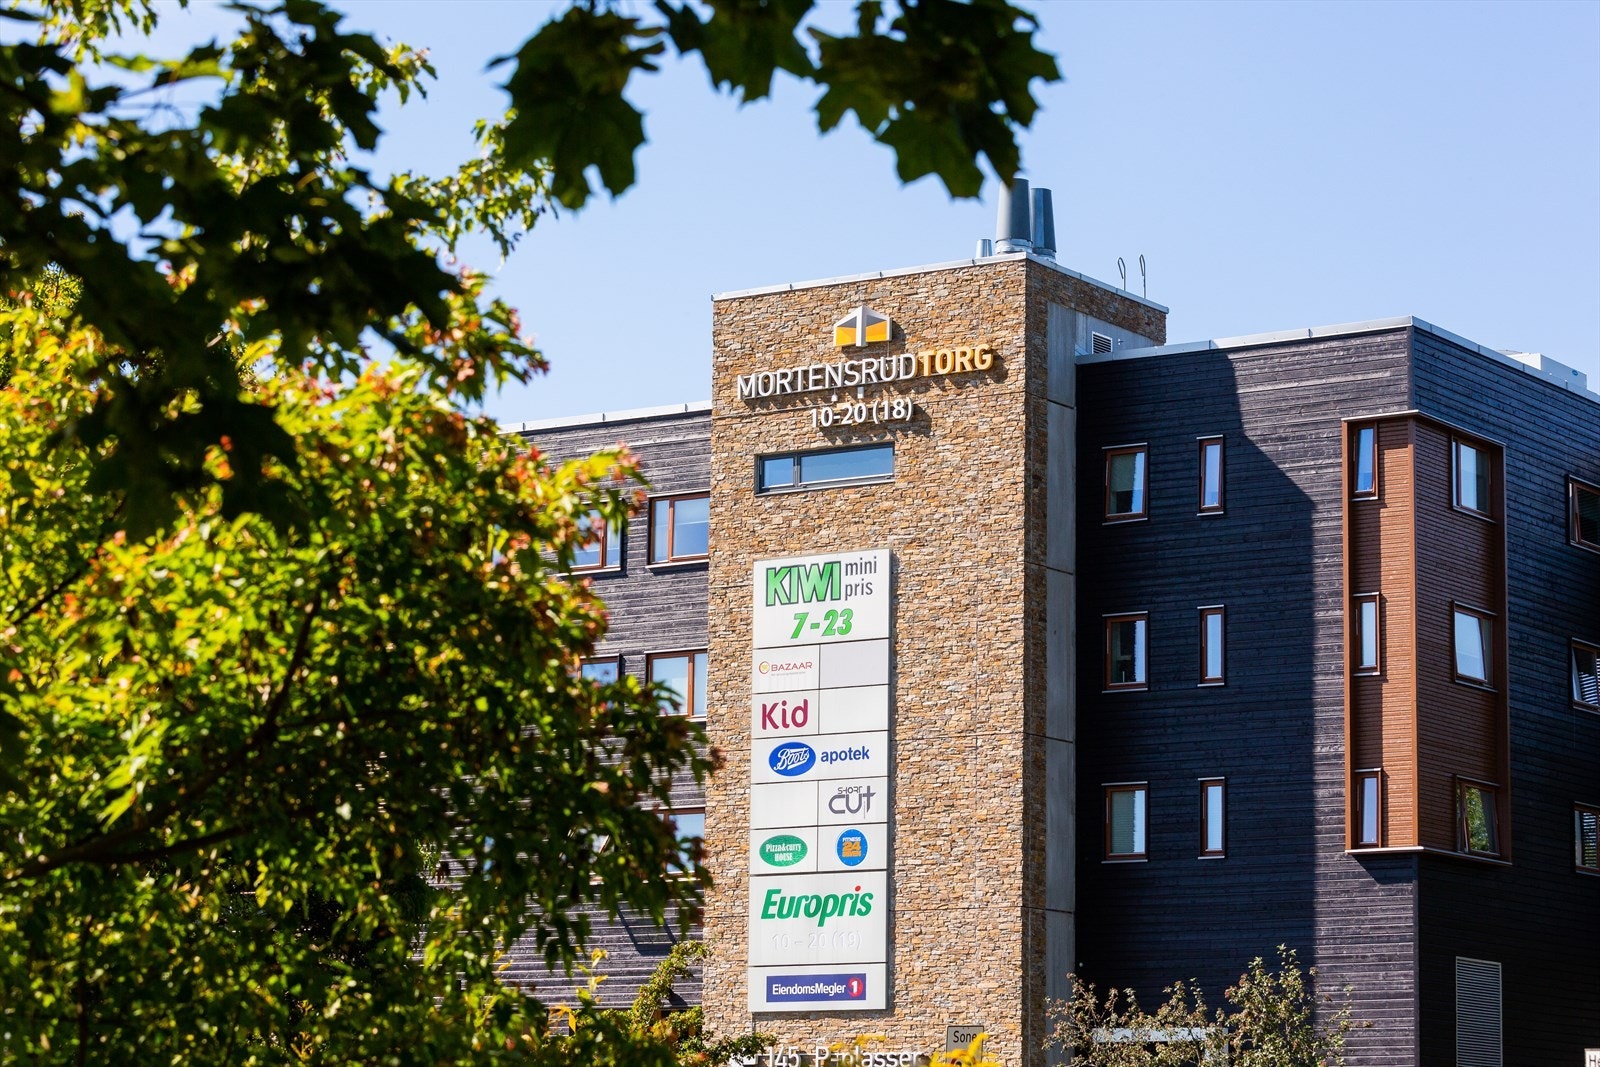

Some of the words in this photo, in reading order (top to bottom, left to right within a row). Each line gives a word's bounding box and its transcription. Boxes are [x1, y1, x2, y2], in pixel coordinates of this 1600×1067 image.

[809, 404, 867, 428] 10-20
[872, 397, 914, 424] (18)
[845, 556, 877, 576] mini
[765, 560, 842, 607] KIWI
[844, 578, 873, 601] pris
[771, 661, 813, 672] BAZAAR
[761, 699, 809, 730] Kid
[774, 747, 809, 770] Boots
[820, 745, 870, 765] apotek
[760, 885, 874, 928] Europris
[772, 982, 847, 997] EiendomsMegler
[952, 1030, 977, 1043] Sone
[763, 1045, 801, 1067] 145
